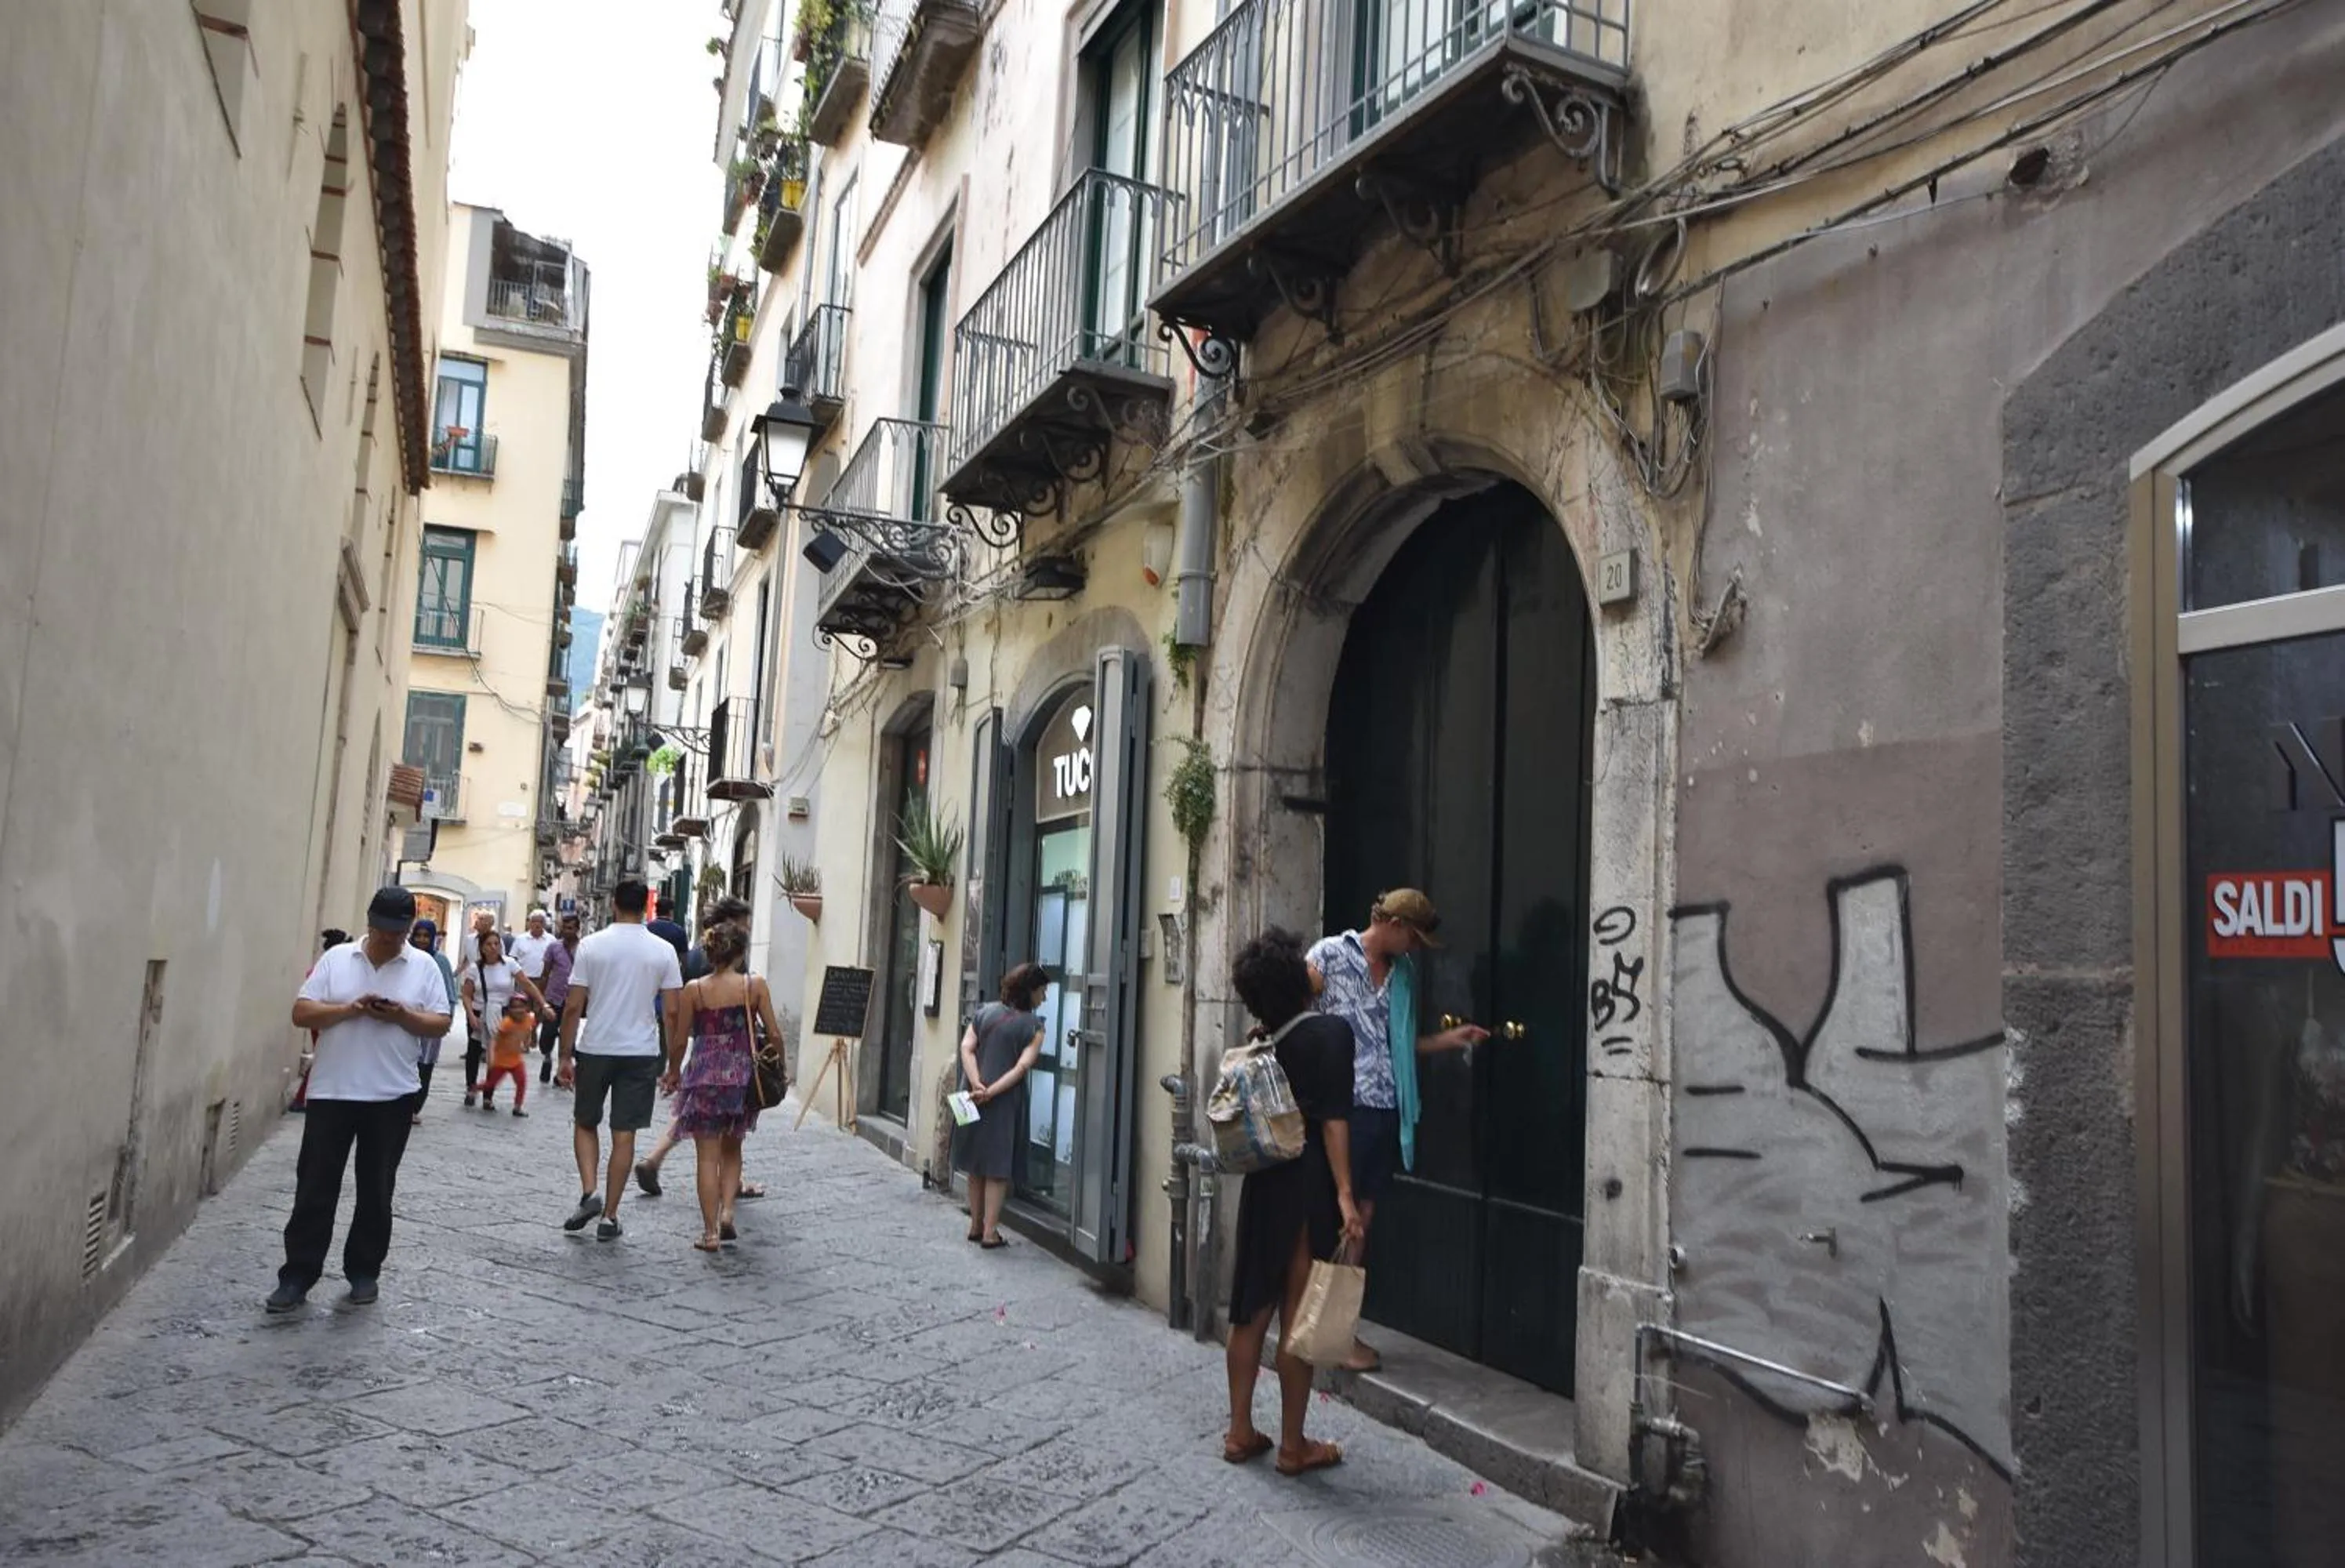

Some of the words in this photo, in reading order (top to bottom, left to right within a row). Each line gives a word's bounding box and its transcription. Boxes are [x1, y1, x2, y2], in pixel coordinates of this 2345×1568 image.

[1606, 562, 1622, 591] 20
[1054, 746, 1094, 798] TUC
[2213, 878, 2324, 938] SALDI
